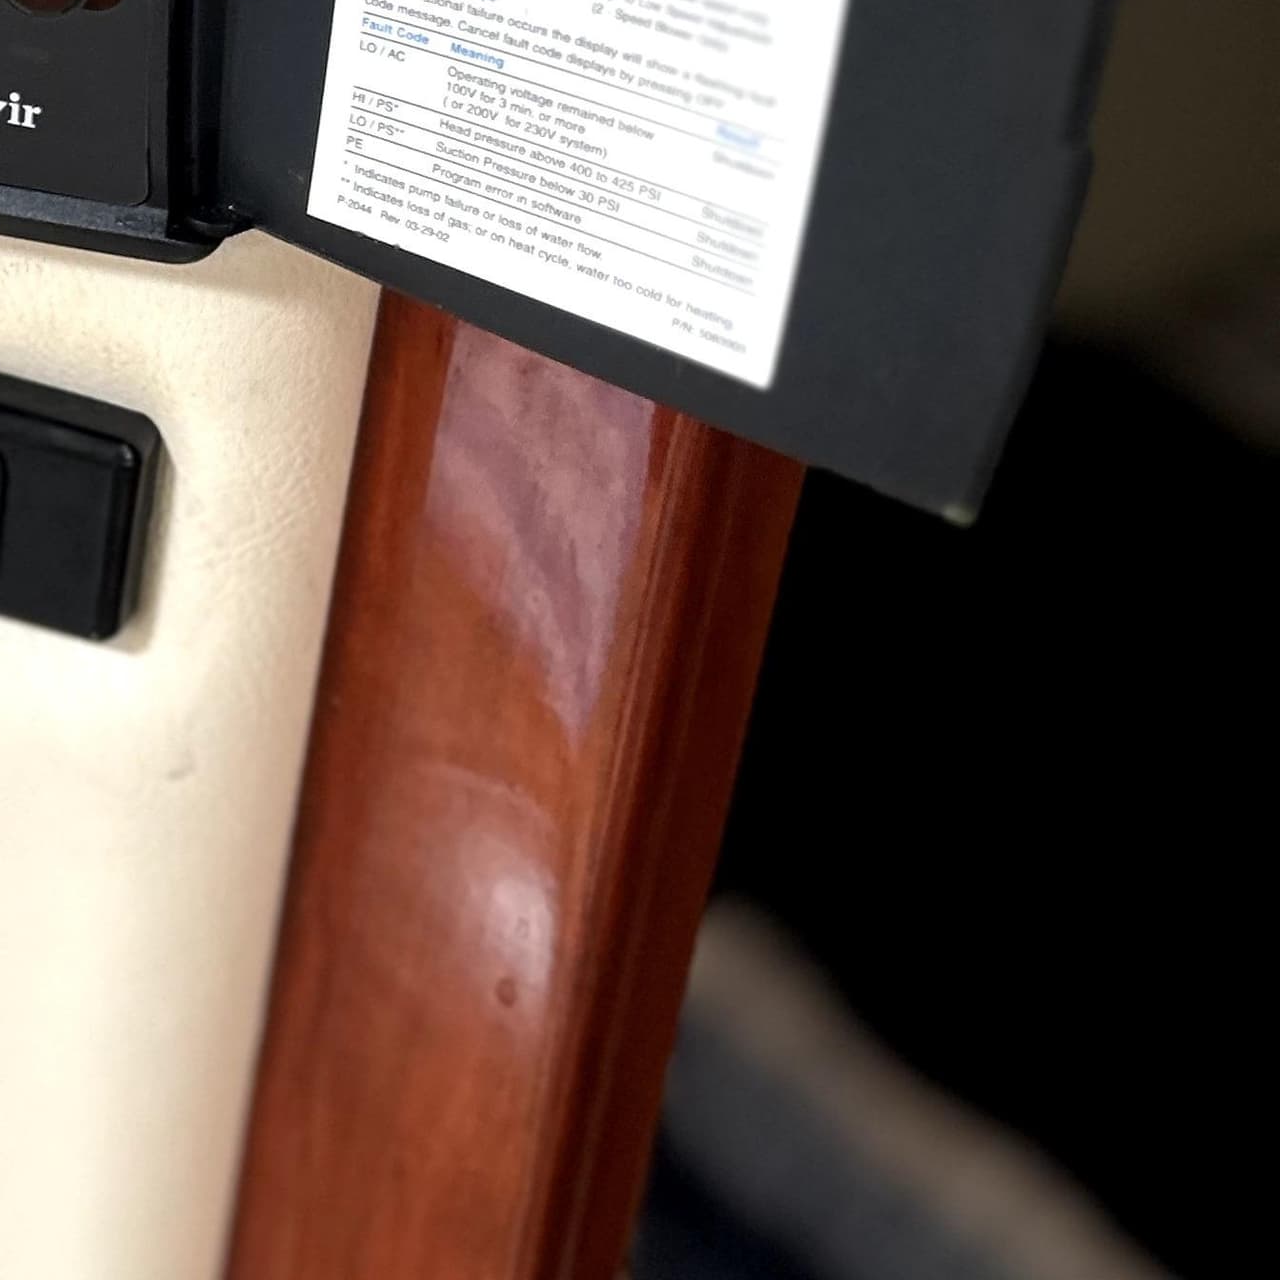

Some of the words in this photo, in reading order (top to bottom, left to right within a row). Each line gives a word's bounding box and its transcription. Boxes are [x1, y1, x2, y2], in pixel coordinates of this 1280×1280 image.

[362, 18, 392, 34] Fault
[397, 27, 429, 44] Code
[451, 42, 504, 69] Meaning
[458, 20, 500, 40] Cancel
[503, 33, 529, 50] fault
[532, 45, 562, 60] code
[566, 54, 616, 76] displays
[620, 70, 634, 84] by
[638, 77, 692, 103] pressing
[467, 4, 504, 23] failure
[508, 18, 548, 36] occurs
[552, 30, 571, 43] the
[575, 37, 618, 58] display
[622, 53, 642, 64] will
[360, 40, 377, 53] LO
[388, 49, 405, 62] AC
[448, 66, 506, 95] Operating
[510, 88, 553, 108] voltage
[557, 102, 615, 127] remained
[618, 120, 654, 140] below
[448, 82, 477, 98] 100V
[480, 92, 496, 104] for
[499, 98, 507, 108] 3
[539, 113, 551, 122] or
[554, 118, 585, 134] more
[452, 100, 464, 109] or
[467, 104, 498, 120] 200V
[505, 115, 521, 128] for
[524, 122, 556, 139] 230V
[560, 136, 607, 158] system)
[346, 136, 363, 149] PE
[432, 164, 481, 188] Program
[485, 184, 514, 199] error
[517, 196, 527, 204] in
[532, 200, 581, 224] software
[350, 114, 366, 126] LO
[436, 141, 479, 164] Suction
[484, 157, 536, 183] Pressure
[540, 176, 575, 196] below
[578, 190, 594, 203] 30
[598, 196, 620, 212] PSI
[352, 92, 365, 103] HI
[440, 119, 472, 137] Head
[474, 132, 526, 155] pressure
[530, 151, 566, 168] above
[570, 163, 592, 177] 400
[596, 172, 608, 182] to
[612, 177, 634, 192] 425
[639, 185, 661, 201] PSI
[354, 182, 403, 207] Indicates
[407, 201, 430, 216] loss
[434, 212, 445, 221] of
[476, 227, 488, 236] or
[490, 232, 505, 243] on
[509, 237, 535, 254] heat
[577, 264, 610, 280] water
[613, 276, 632, 290] too
[636, 286, 662, 302] cold
[666, 294, 682, 308] for
[355, 165, 405, 190] Indicates
[408, 185, 441, 202] pump
[445, 195, 480, 216] failure
[483, 211, 495, 220] or
[498, 215, 522, 230] loss
[526, 226, 538, 236] of
[542, 232, 573, 248] water
